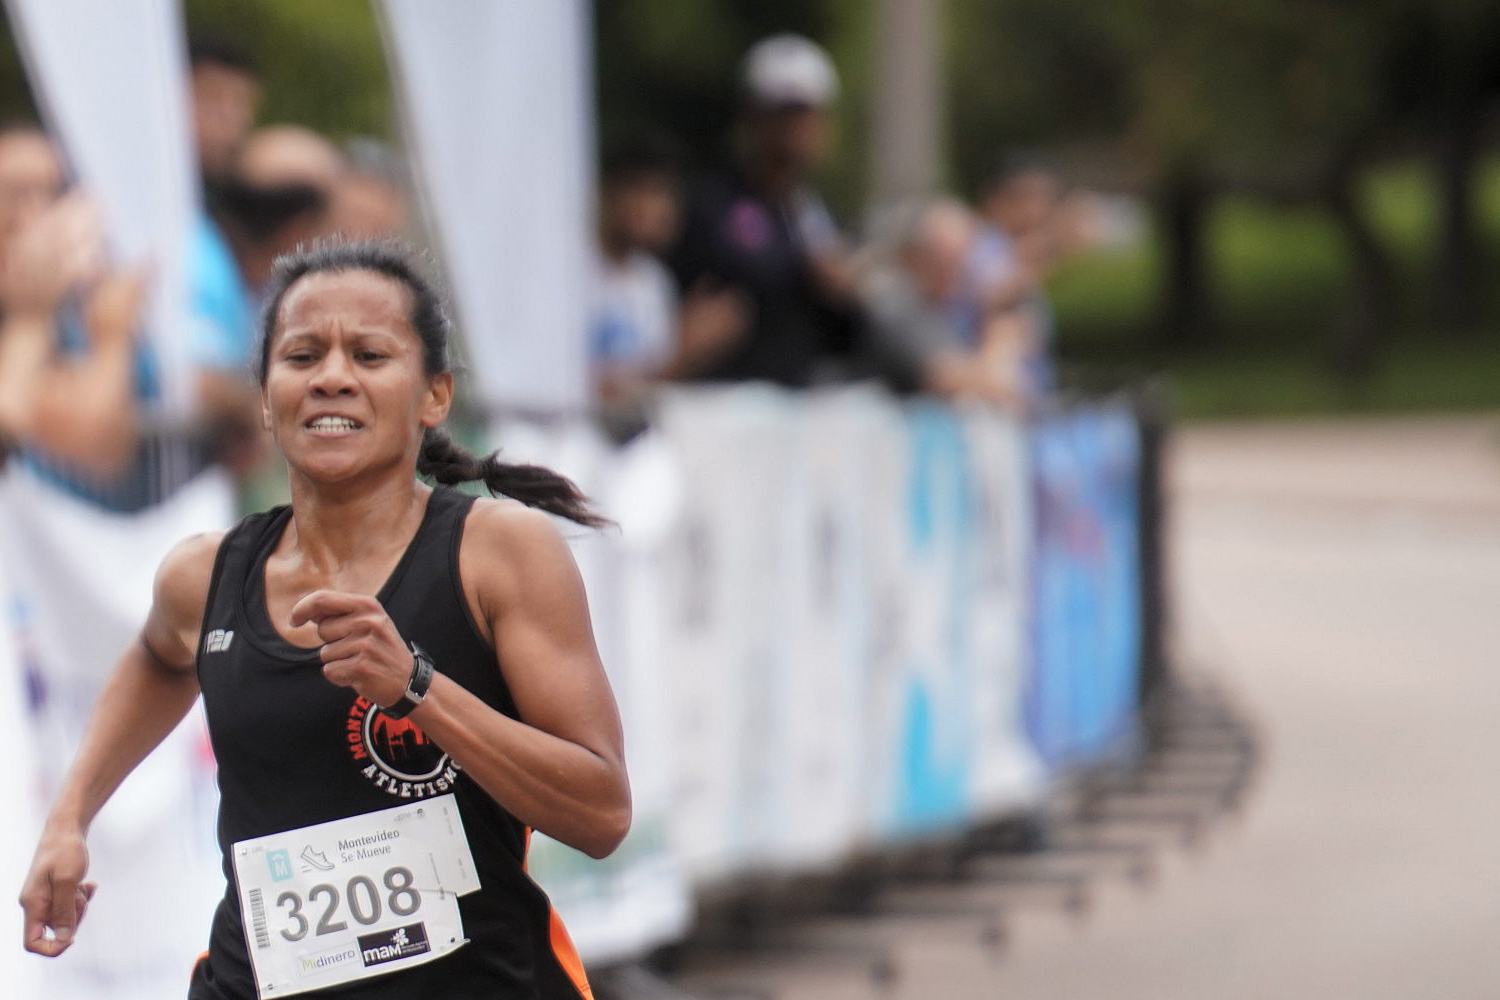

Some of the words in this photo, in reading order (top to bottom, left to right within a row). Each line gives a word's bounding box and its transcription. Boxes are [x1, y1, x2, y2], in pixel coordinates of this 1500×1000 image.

[346, 695, 372, 760] MONTE
[338, 828, 400, 851] Montevideo
[340, 852, 354, 864] Se
[356, 845, 392, 861] Mueve
[276, 866, 422, 942] 3208
[302, 949, 356, 972] Midinero
